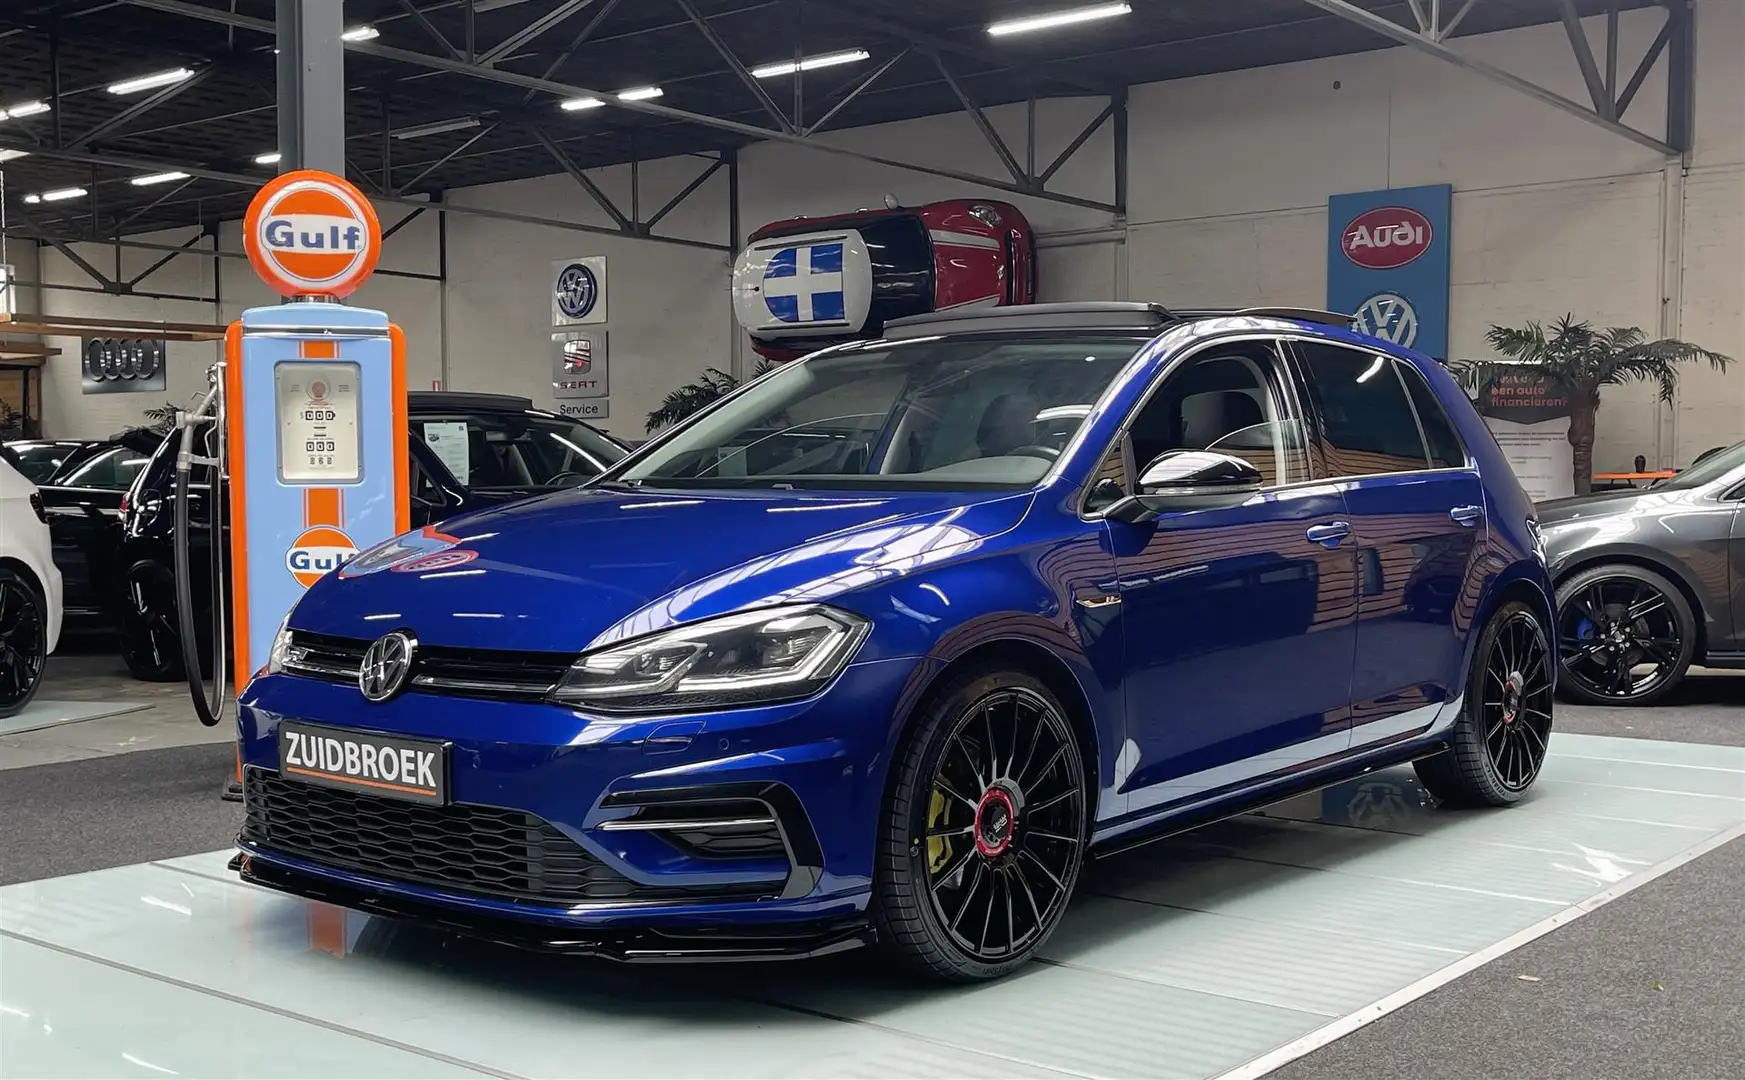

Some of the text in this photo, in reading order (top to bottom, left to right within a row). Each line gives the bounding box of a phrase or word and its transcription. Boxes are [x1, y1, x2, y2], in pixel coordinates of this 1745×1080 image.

[265, 220, 360, 250] Gulf
[560, 380, 597, 389] SEAT
[1491, 386, 1545, 395] een auto
[559, 404, 599, 415] Service
[290, 551, 356, 570] Gul
[285, 731, 436, 787] ZUIDBROEK
